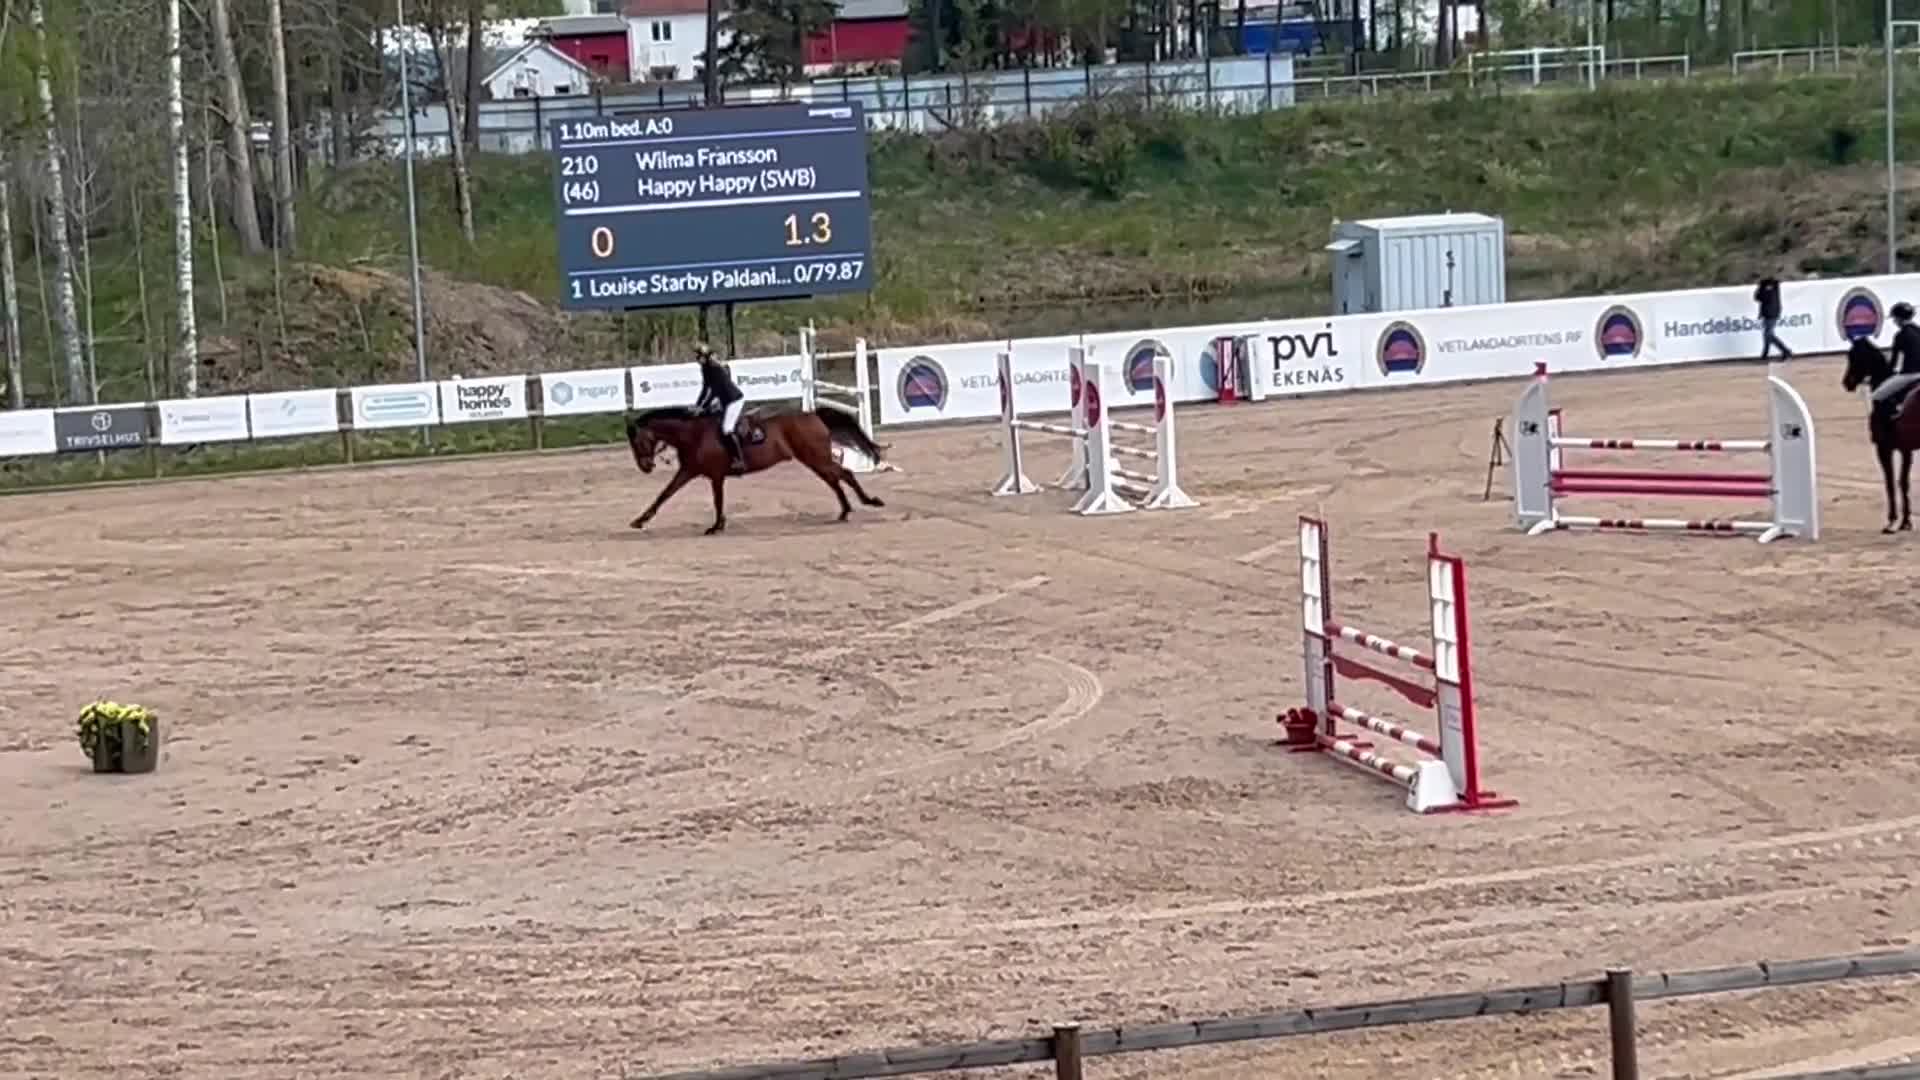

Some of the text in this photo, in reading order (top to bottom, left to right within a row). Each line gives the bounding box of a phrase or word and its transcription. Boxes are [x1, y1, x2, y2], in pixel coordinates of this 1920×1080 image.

[560, 117, 673, 140] 1.10m bed. A:0
[561, 148, 777, 176] 210 Wilma Fransson
[563, 166, 816, 204] (46) Happy Happy (SWB)
[592, 226, 614, 258] 0
[784, 211, 832, 246] 1.3
[571, 261, 864, 299] 1 Louise Starby Paldani... 0/79.87
[1267, 322, 1338, 370] pvi
[1436, 330, 1583, 353] VETLANDAORTENS RF
[1272, 366, 1344, 387] EKENÄS
[457, 384, 505, 399] happy
[458, 396, 512, 410] homes
